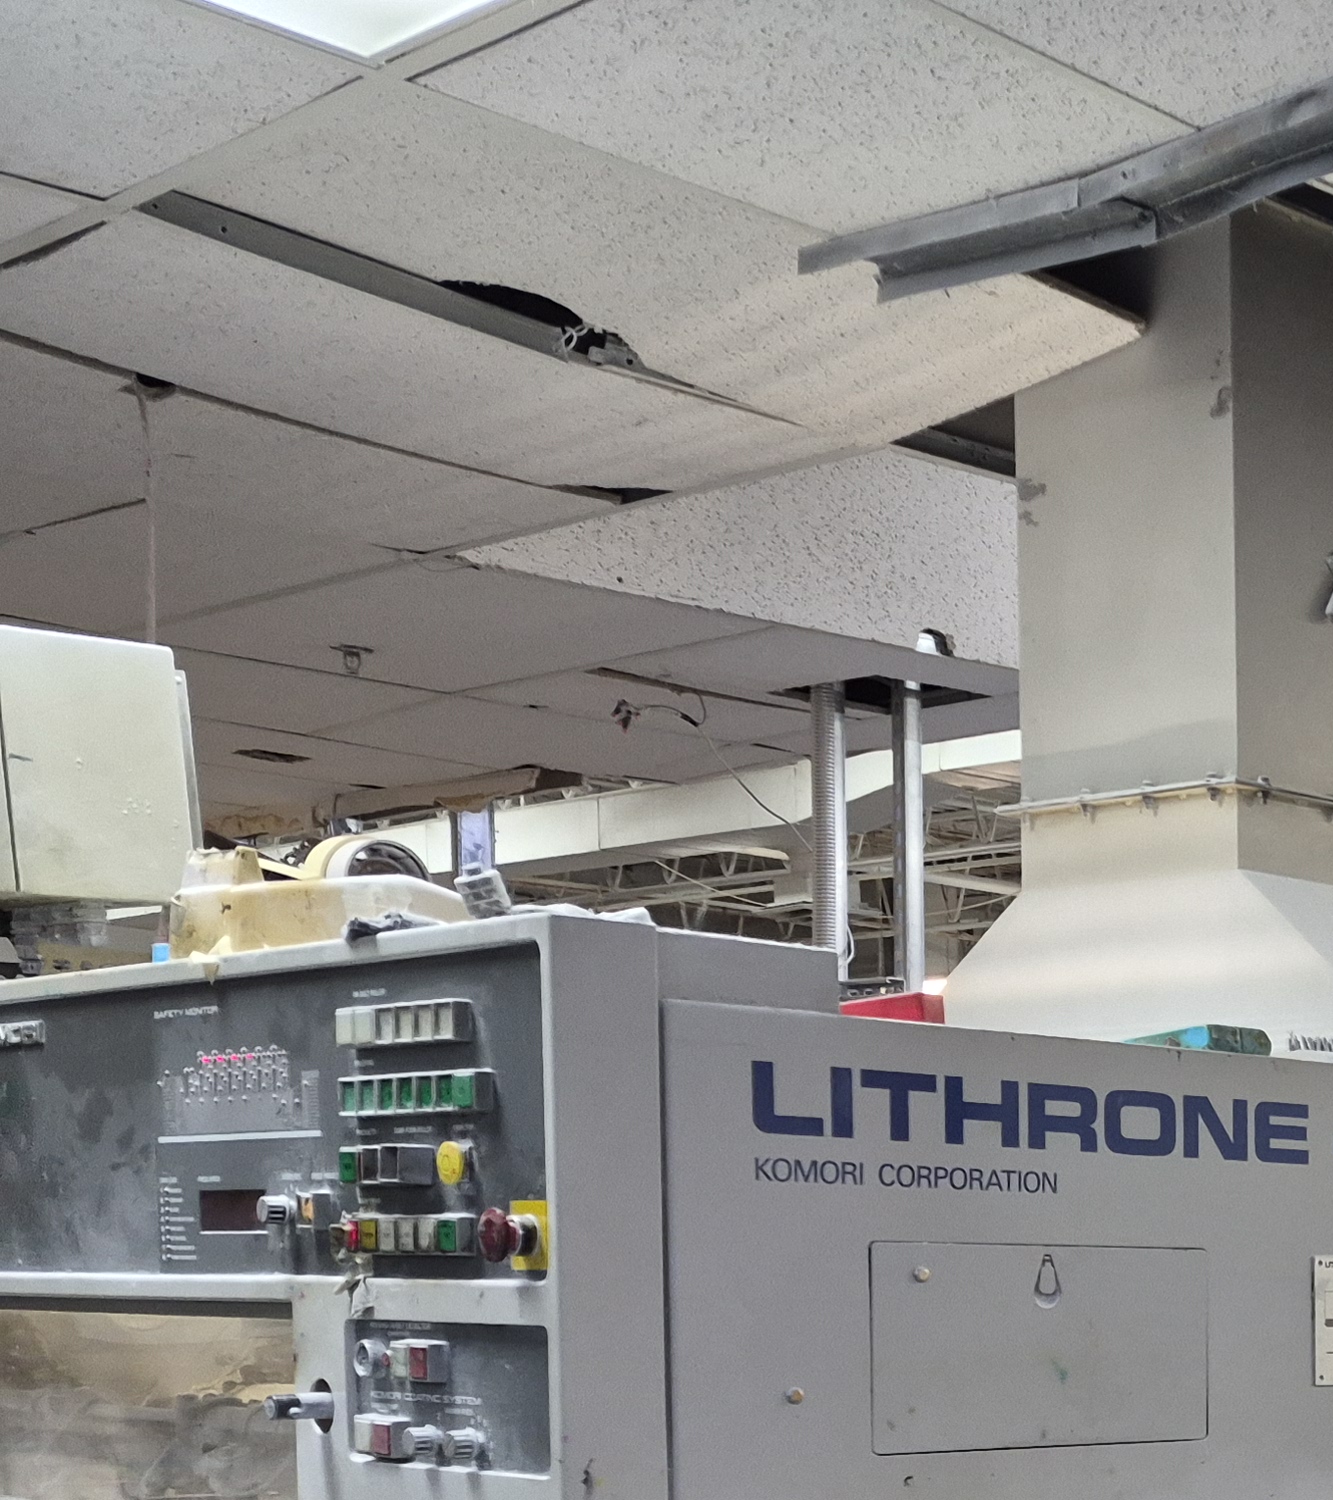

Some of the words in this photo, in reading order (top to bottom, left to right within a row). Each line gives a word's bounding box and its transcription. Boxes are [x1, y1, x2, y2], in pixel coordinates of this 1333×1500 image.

[750, 1060, 1310, 1166] LITHRONE
[754, 1157, 864, 1186] KOMORI
[878, 1162, 1059, 1195] CORPORATION
